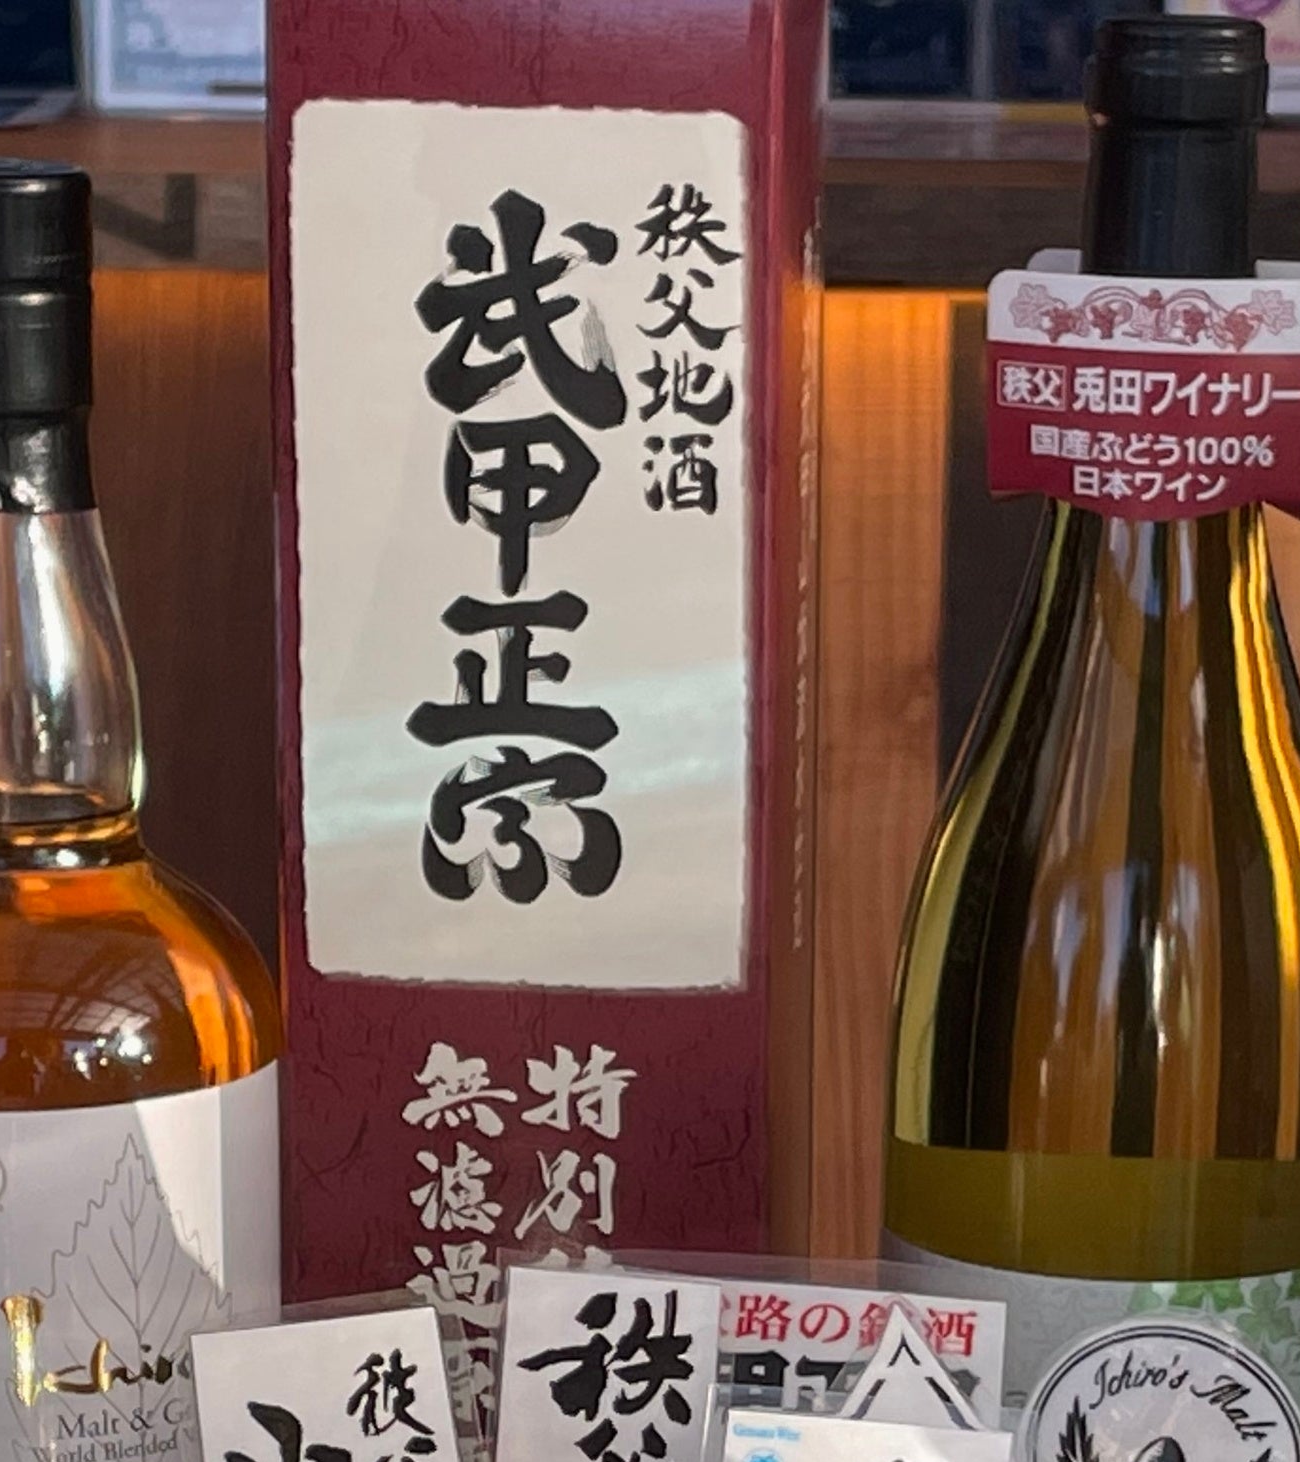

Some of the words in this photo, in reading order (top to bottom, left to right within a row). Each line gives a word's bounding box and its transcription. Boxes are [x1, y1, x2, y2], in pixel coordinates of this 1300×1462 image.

[632, 183, 743, 515] 秩父地酒
[1002, 366, 1062, 407] 秩父
[1030, 424, 1275, 468] 国産ぶどう100%
[1072, 466, 1227, 500] 日本ワイン
[406, 188, 628, 905] 武甲正宗
[1089, 1350, 1190, 1410] Ichiro's
[1190, 1374, 1278, 1441] Malt
[57, 1409, 120, 1440] Malt
[130, 1404, 153, 1433] &
[105, 1428, 179, 1461] Blended
